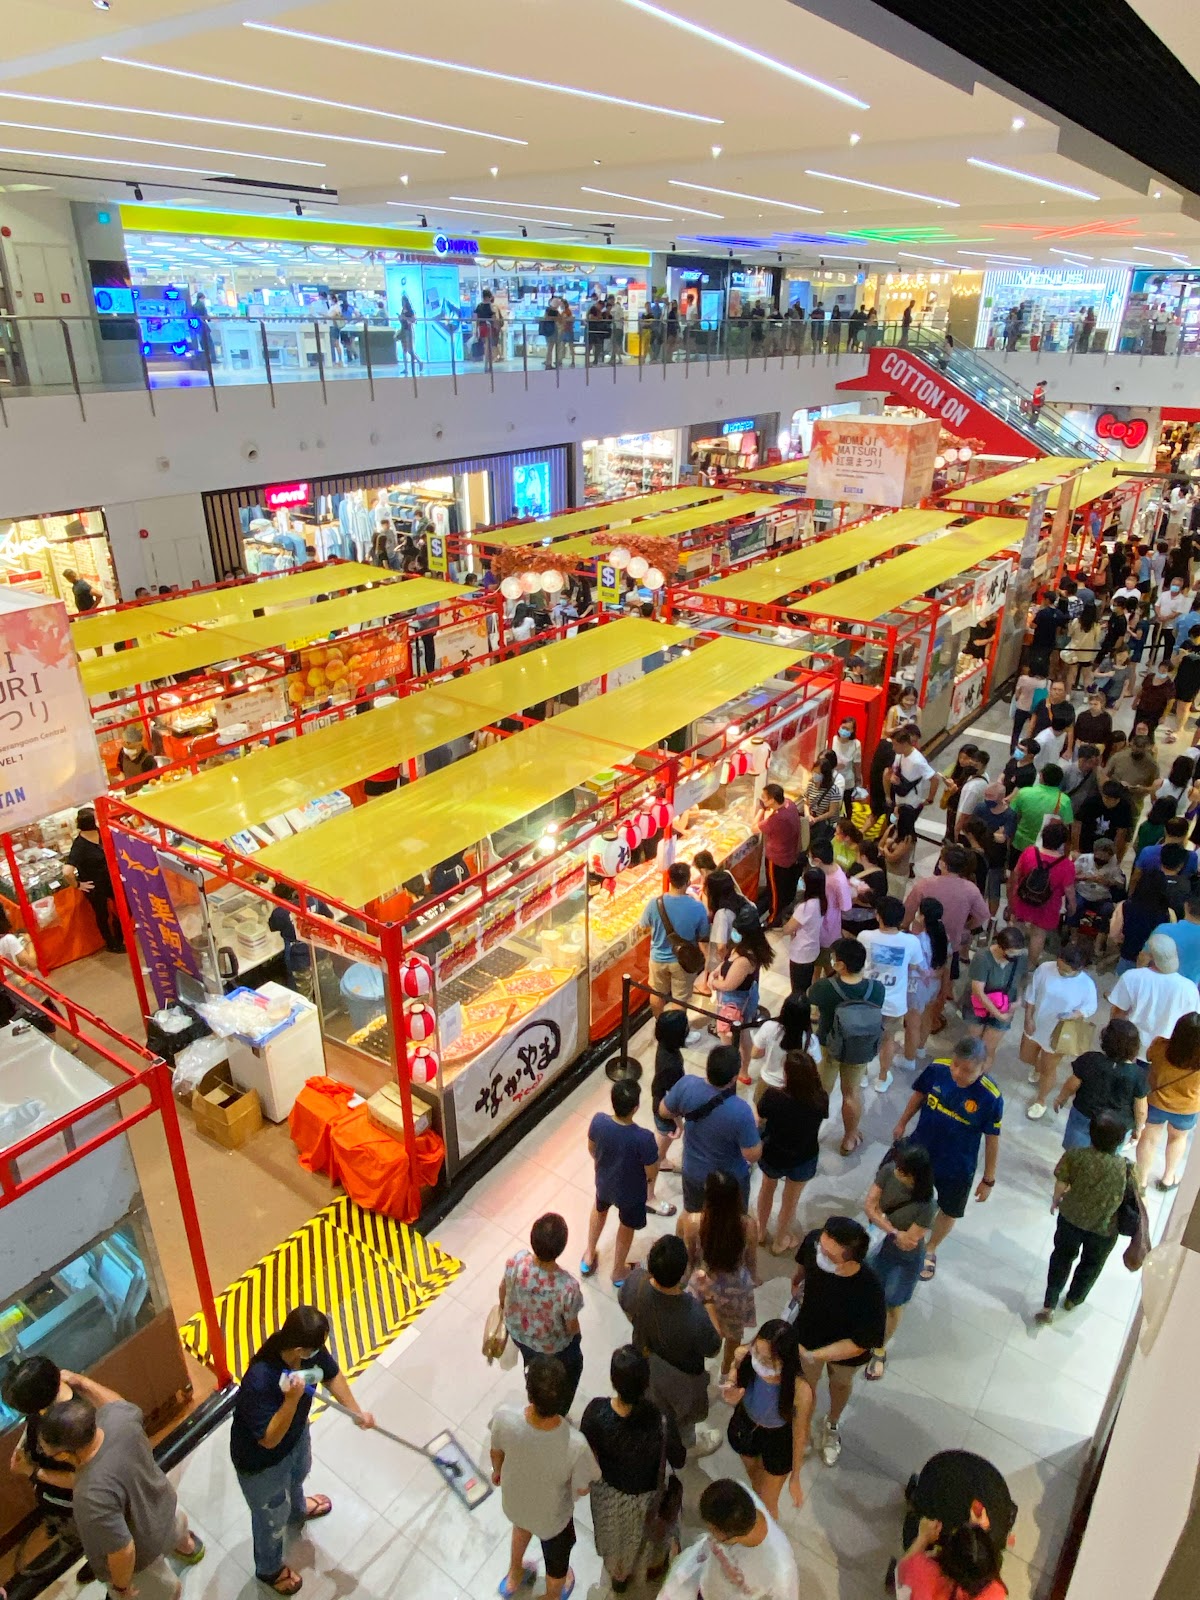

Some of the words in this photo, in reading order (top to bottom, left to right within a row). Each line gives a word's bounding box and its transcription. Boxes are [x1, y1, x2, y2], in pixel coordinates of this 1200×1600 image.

[881, 352, 945, 409] COTTON
[940, 398, 970, 428] ON
[840, 434, 878, 446] MOMIJI
[838, 445, 882, 457] MATSURI
[40, 726, 67, 740] Central
[475, 1019, 561, 1118] なかやま
